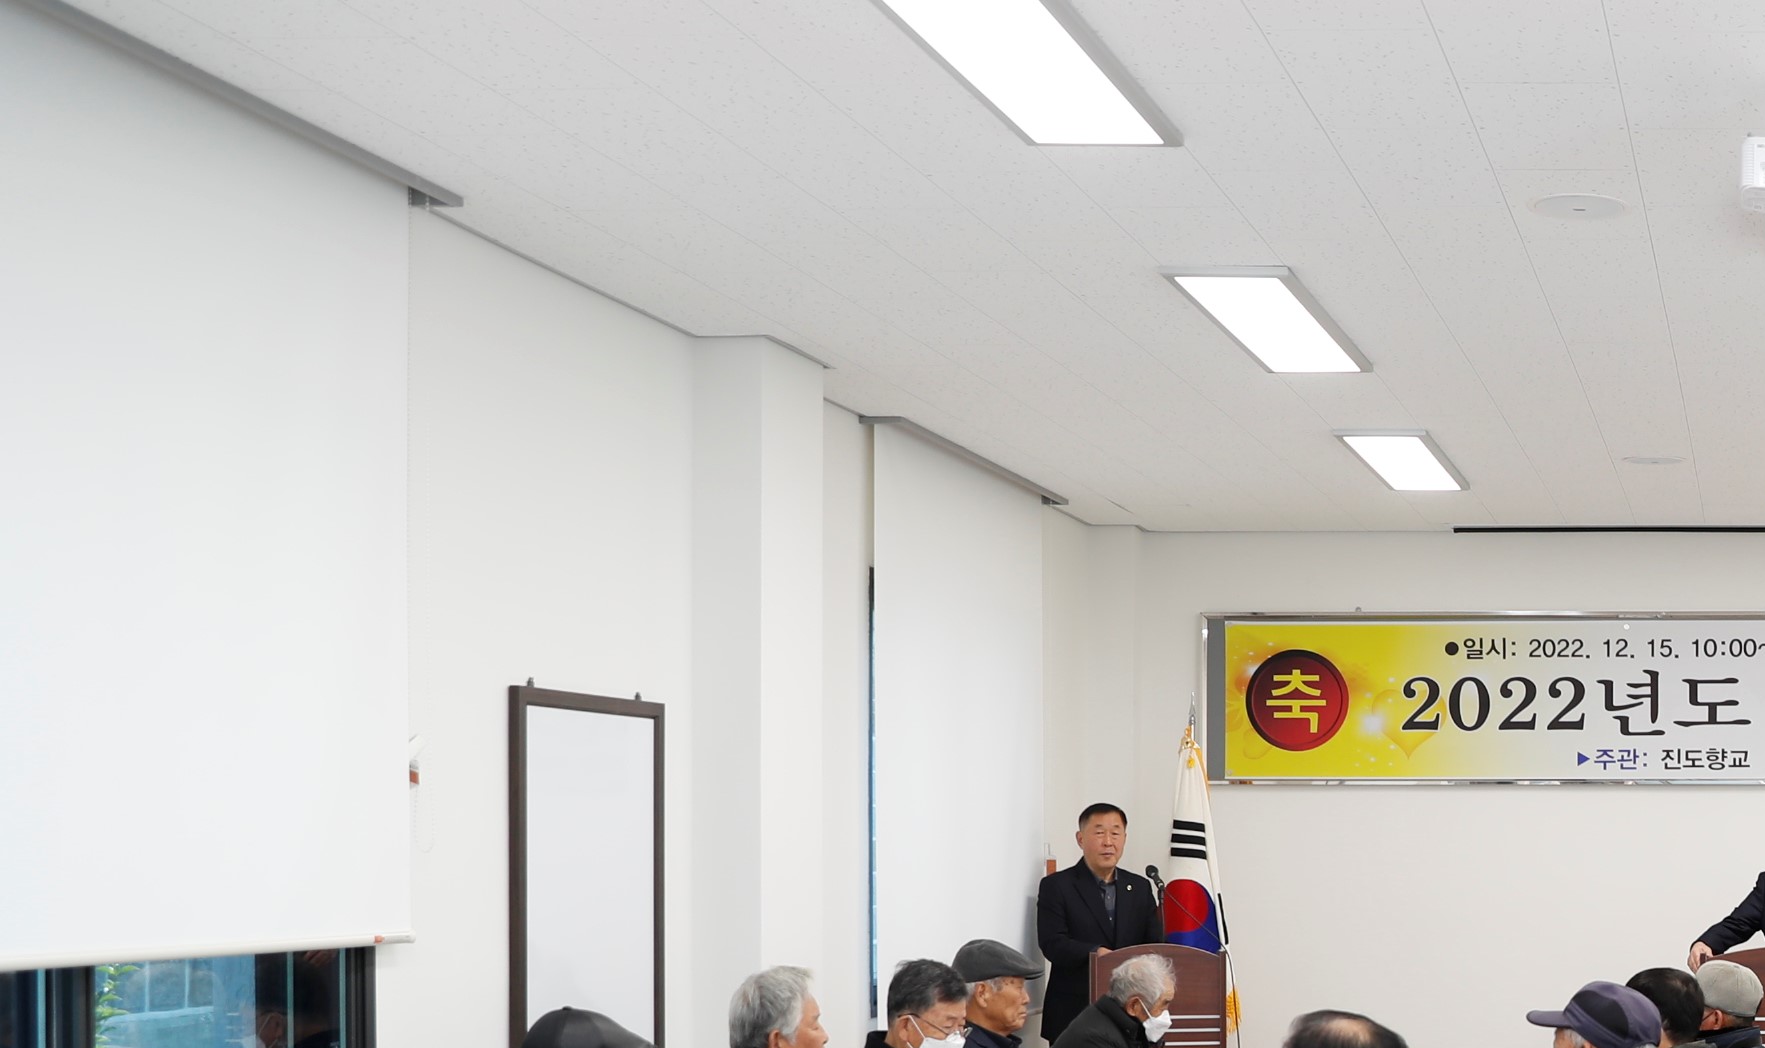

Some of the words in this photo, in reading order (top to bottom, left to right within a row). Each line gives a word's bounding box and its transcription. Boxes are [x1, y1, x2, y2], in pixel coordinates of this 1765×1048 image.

[1463, 637, 1516, 660] 일시:
[1528, 638, 1591, 659] 2022.
[1602, 638, 1635, 659] 12.
[1647, 638, 1679, 659] 15.
[1265, 669, 1327, 734] 축
[1401, 669, 1752, 736] 2022년도
[1593, 748, 1648, 770] 주관:
[1660, 748, 1751, 771] 진도향교
